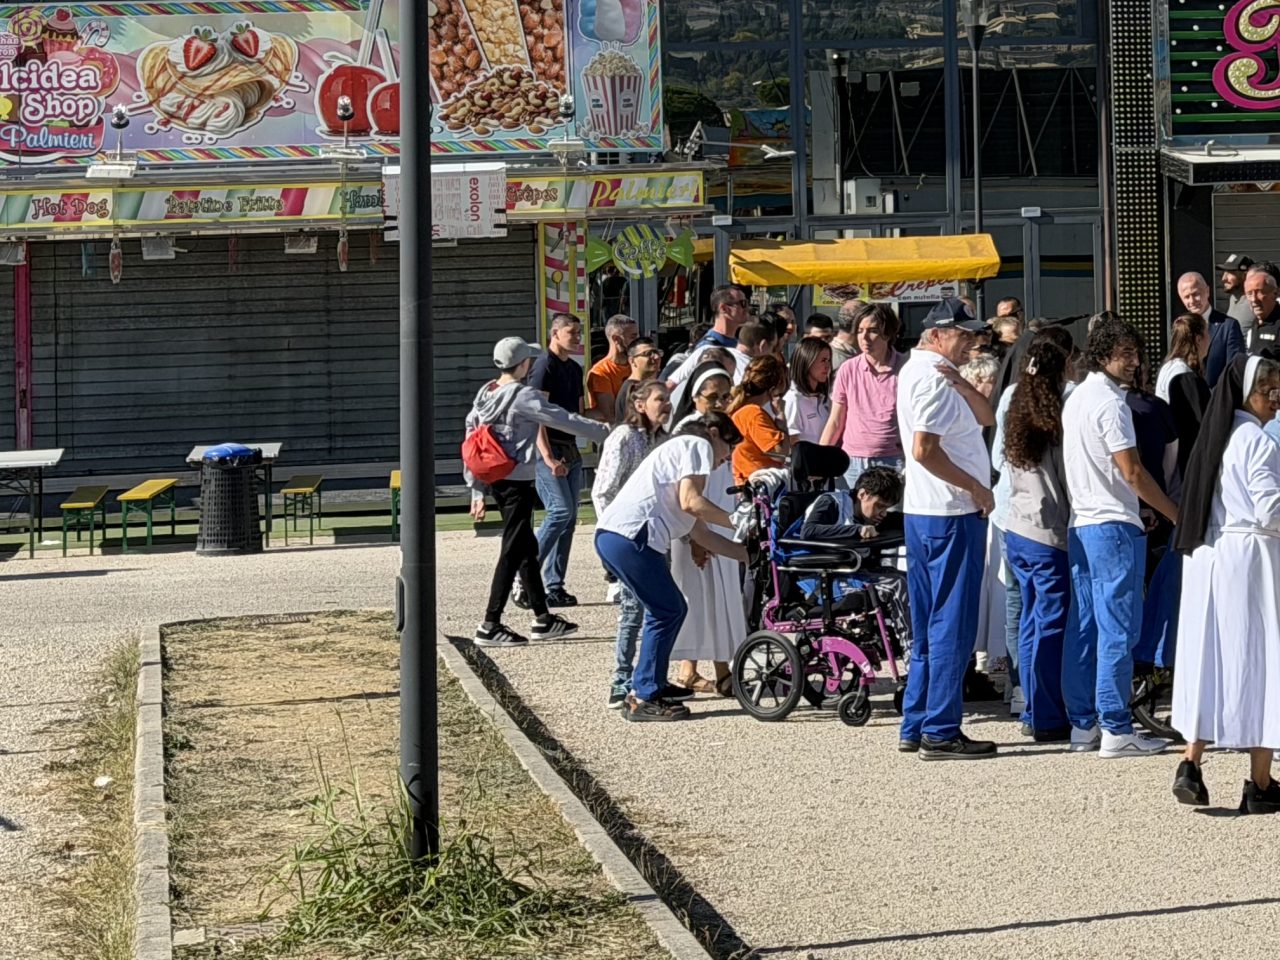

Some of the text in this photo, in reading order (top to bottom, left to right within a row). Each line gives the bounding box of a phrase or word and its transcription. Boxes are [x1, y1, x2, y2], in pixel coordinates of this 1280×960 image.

[23, 92, 95, 121] Shop
[1, 126, 96, 150] Palmieri
[165, 194, 233, 214] Patatine
[469, 177, 483, 222] exolon
[506, 184, 558, 206] Crêpes
[592, 178, 699, 208] Palmieri
[32, 197, 109, 219] Hot Dog
